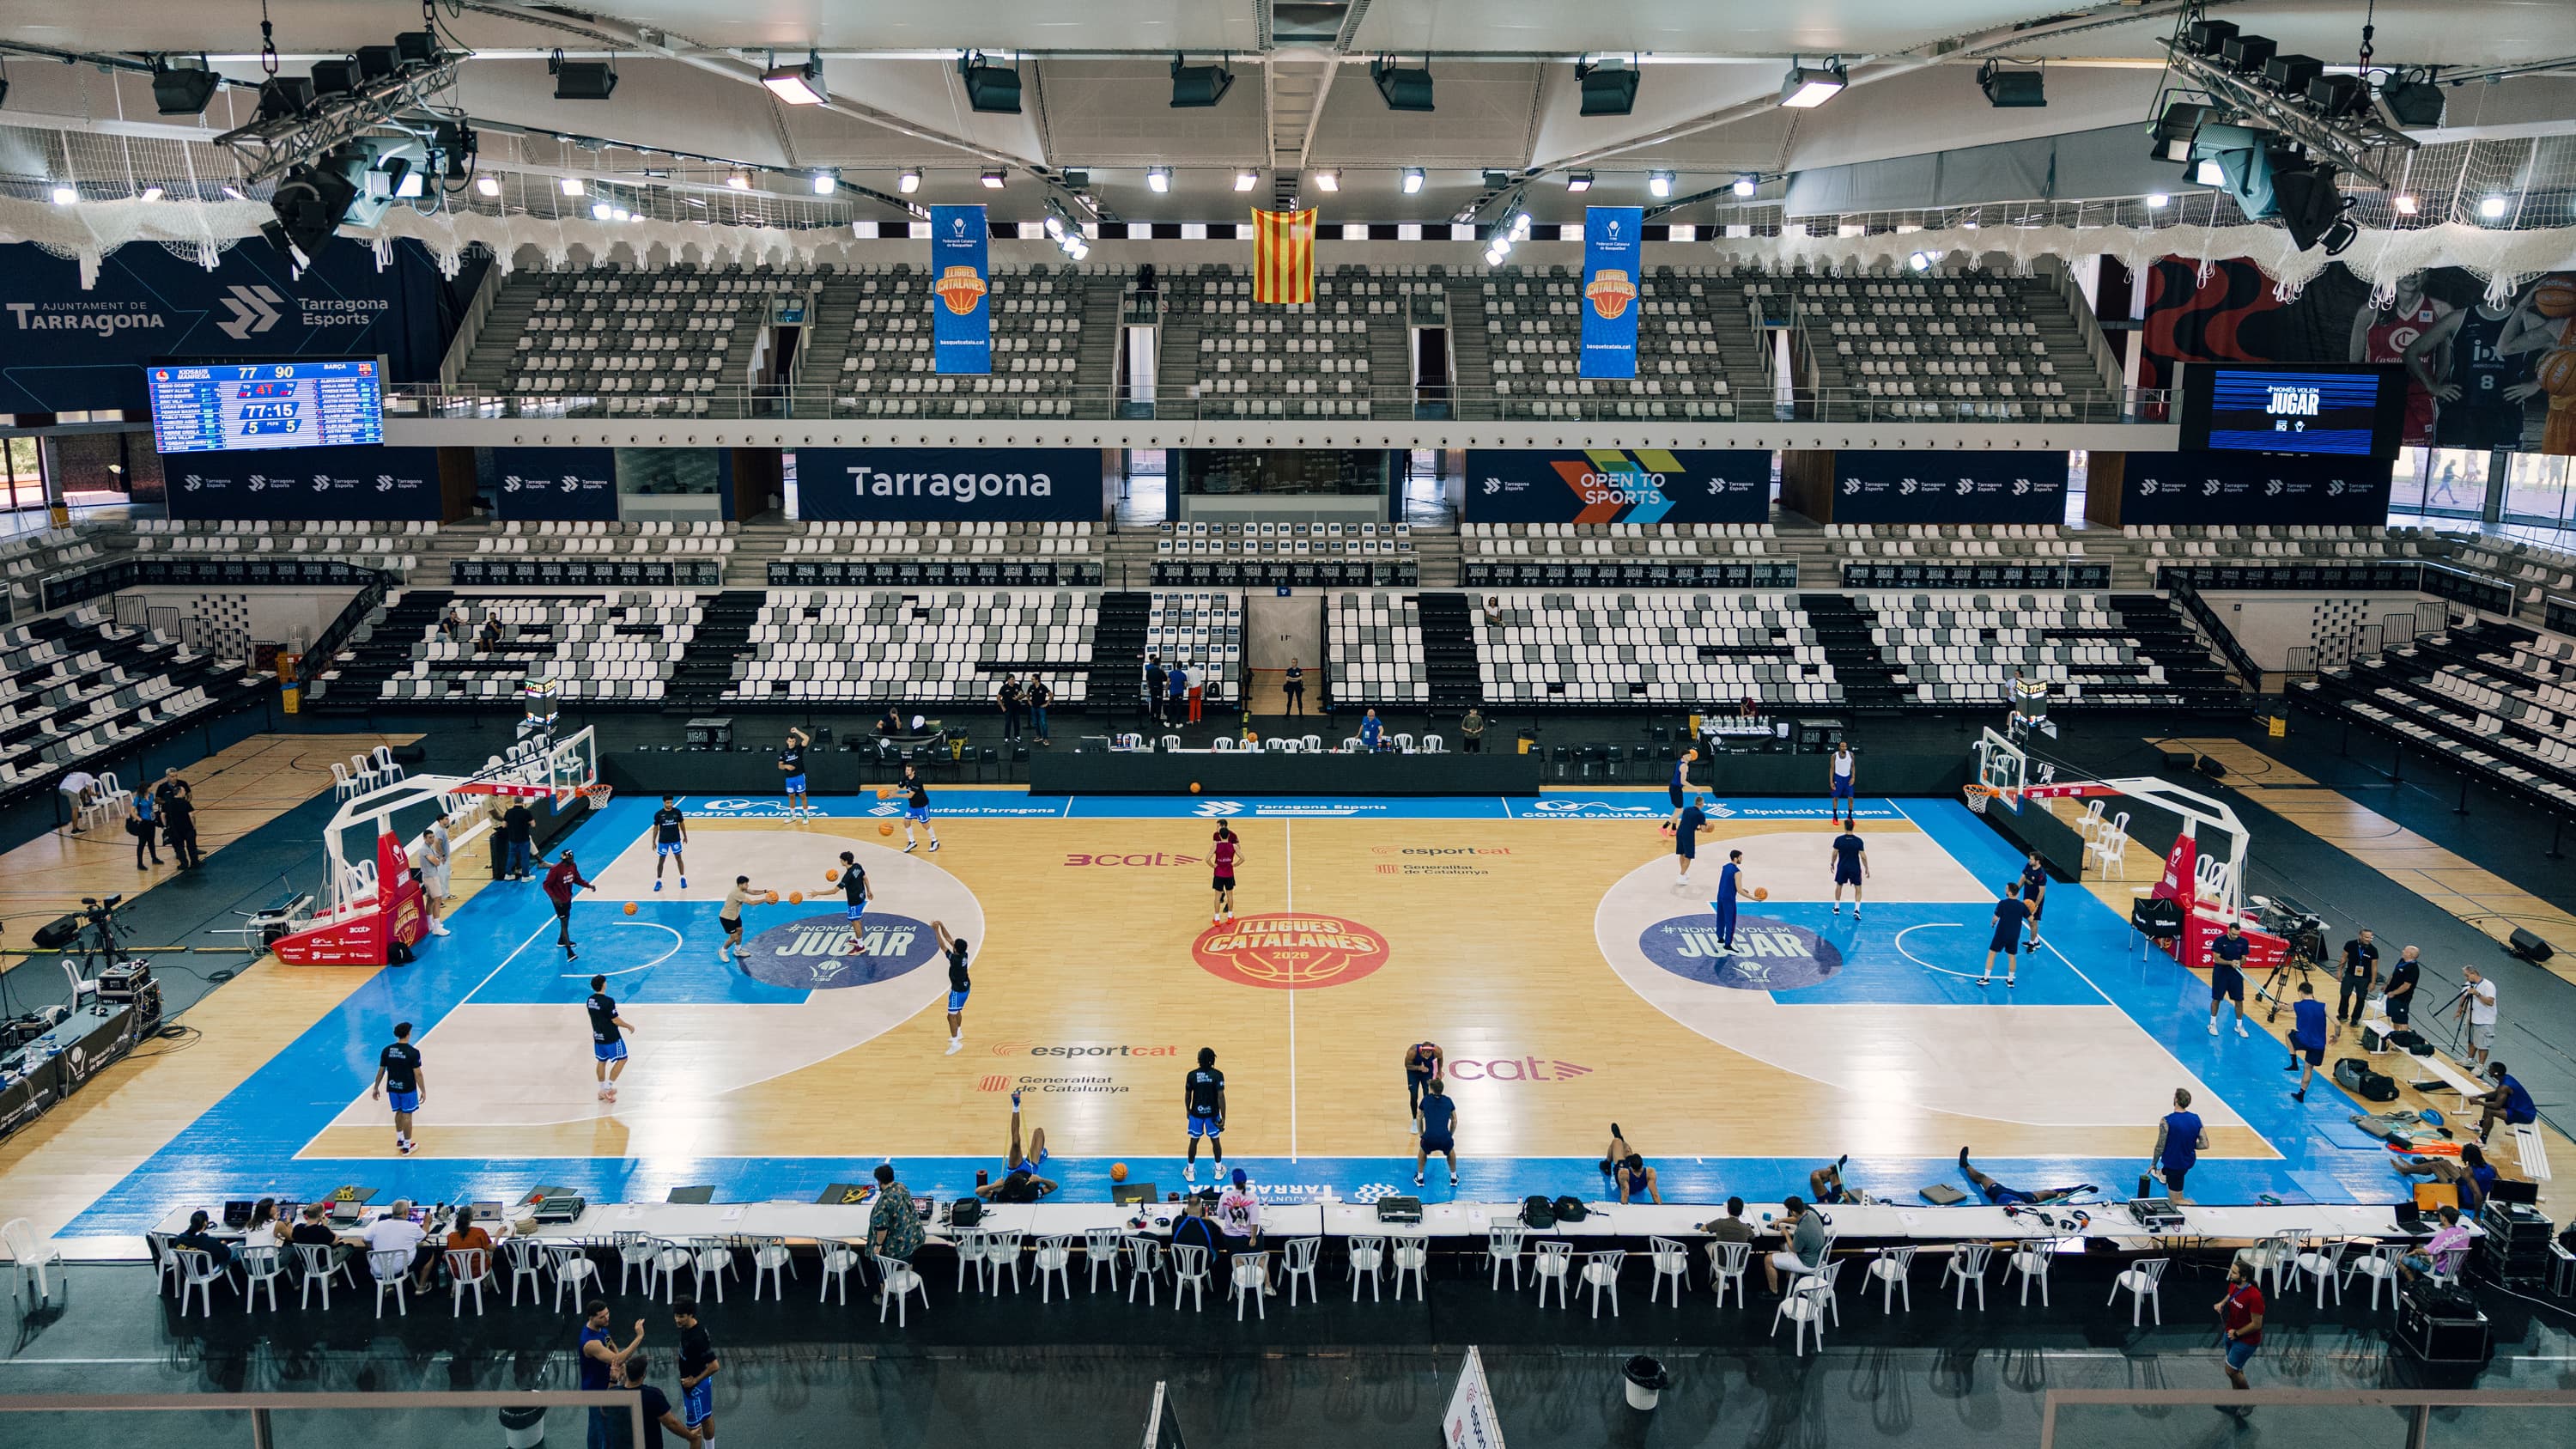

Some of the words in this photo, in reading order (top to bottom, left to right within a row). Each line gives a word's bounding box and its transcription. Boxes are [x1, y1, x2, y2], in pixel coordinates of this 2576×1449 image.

[945, 267, 975, 278] LLIGUES
[1596, 271, 1626, 282] LLIGUES
[937, 277, 985, 293] CATALANES
[1587, 281, 1635, 296] CATALANES
[42, 302, 125, 311] AJUNTAMENT
[131, 301, 148, 310] DE
[298, 297, 389, 313] Tarragona
[303, 312, 369, 326] Esports
[239, 367, 258, 379] 77
[275, 366, 294, 378] 90
[2481, 374, 2494, 389] 8
[256, 383, 274, 395] 4T
[2266, 392, 2319, 416] JUGAR
[246, 404, 294, 417] 77:15
[248, 422, 258, 434] 5
[286, 420, 295, 432] 5
[847, 466, 1052, 503] Tarragona
[1580, 473, 1633, 488] OPEN
[1639, 473, 1666, 487] TO
[1584, 490, 1661, 505] SPORTS
[464, 567, 483, 575] JUGAR
[542, 567, 561, 575] JUGAR
[568, 567, 586, 575] JUGAR
[646, 567, 665, 575] JUGAR
[770, 567, 789, 576] JUGAR
[848, 567, 866, 576] JUGAR
[874, 567, 893, 576] JUGAR
[951, 567, 970, 576] JUGAR
[1004, 567, 1023, 576] JUGAR
[1165, 568, 1184, 576] JUGAR
[1191, 568, 1210, 576] JUGAR
[1268, 568, 1287, 576] JUGAR
[1320, 568, 1339, 576] JUGAR
[1469, 569, 1488, 577] JUGAR
[1495, 569, 1514, 577] JUGAR
[1572, 569, 1591, 577] JUGAR
[1624, 569, 1643, 577] JUGAR
[1701, 569, 1720, 577] JUGAR
[1727, 569, 1746, 577] JUGAR
[1875, 569, 1894, 578] JUGAR
[1927, 569, 1946, 578] JUGAR
[2003, 569, 2022, 578] JUGAR
[2029, 569, 2048, 578] JUGAR
[1402, 847, 1512, 856] esportcat
[1064, 852, 1170, 866] 3cat
[785, 923, 856, 933] #NOMÉS
[1242, 920, 1337, 934] LLIGUES
[775, 932, 915, 956] JUGAR
[1208, 933, 1374, 952] CATALANES
[1677, 933, 1813, 958] JUGAR
[1273, 951, 1309, 959] 2026
[1030, 1044, 1177, 1059] esportcat
[1449, 1056, 1551, 1081] cat
[1019, 1075, 1114, 1084] Generalitat
[1042, 1085, 1130, 1093] Catalunya
